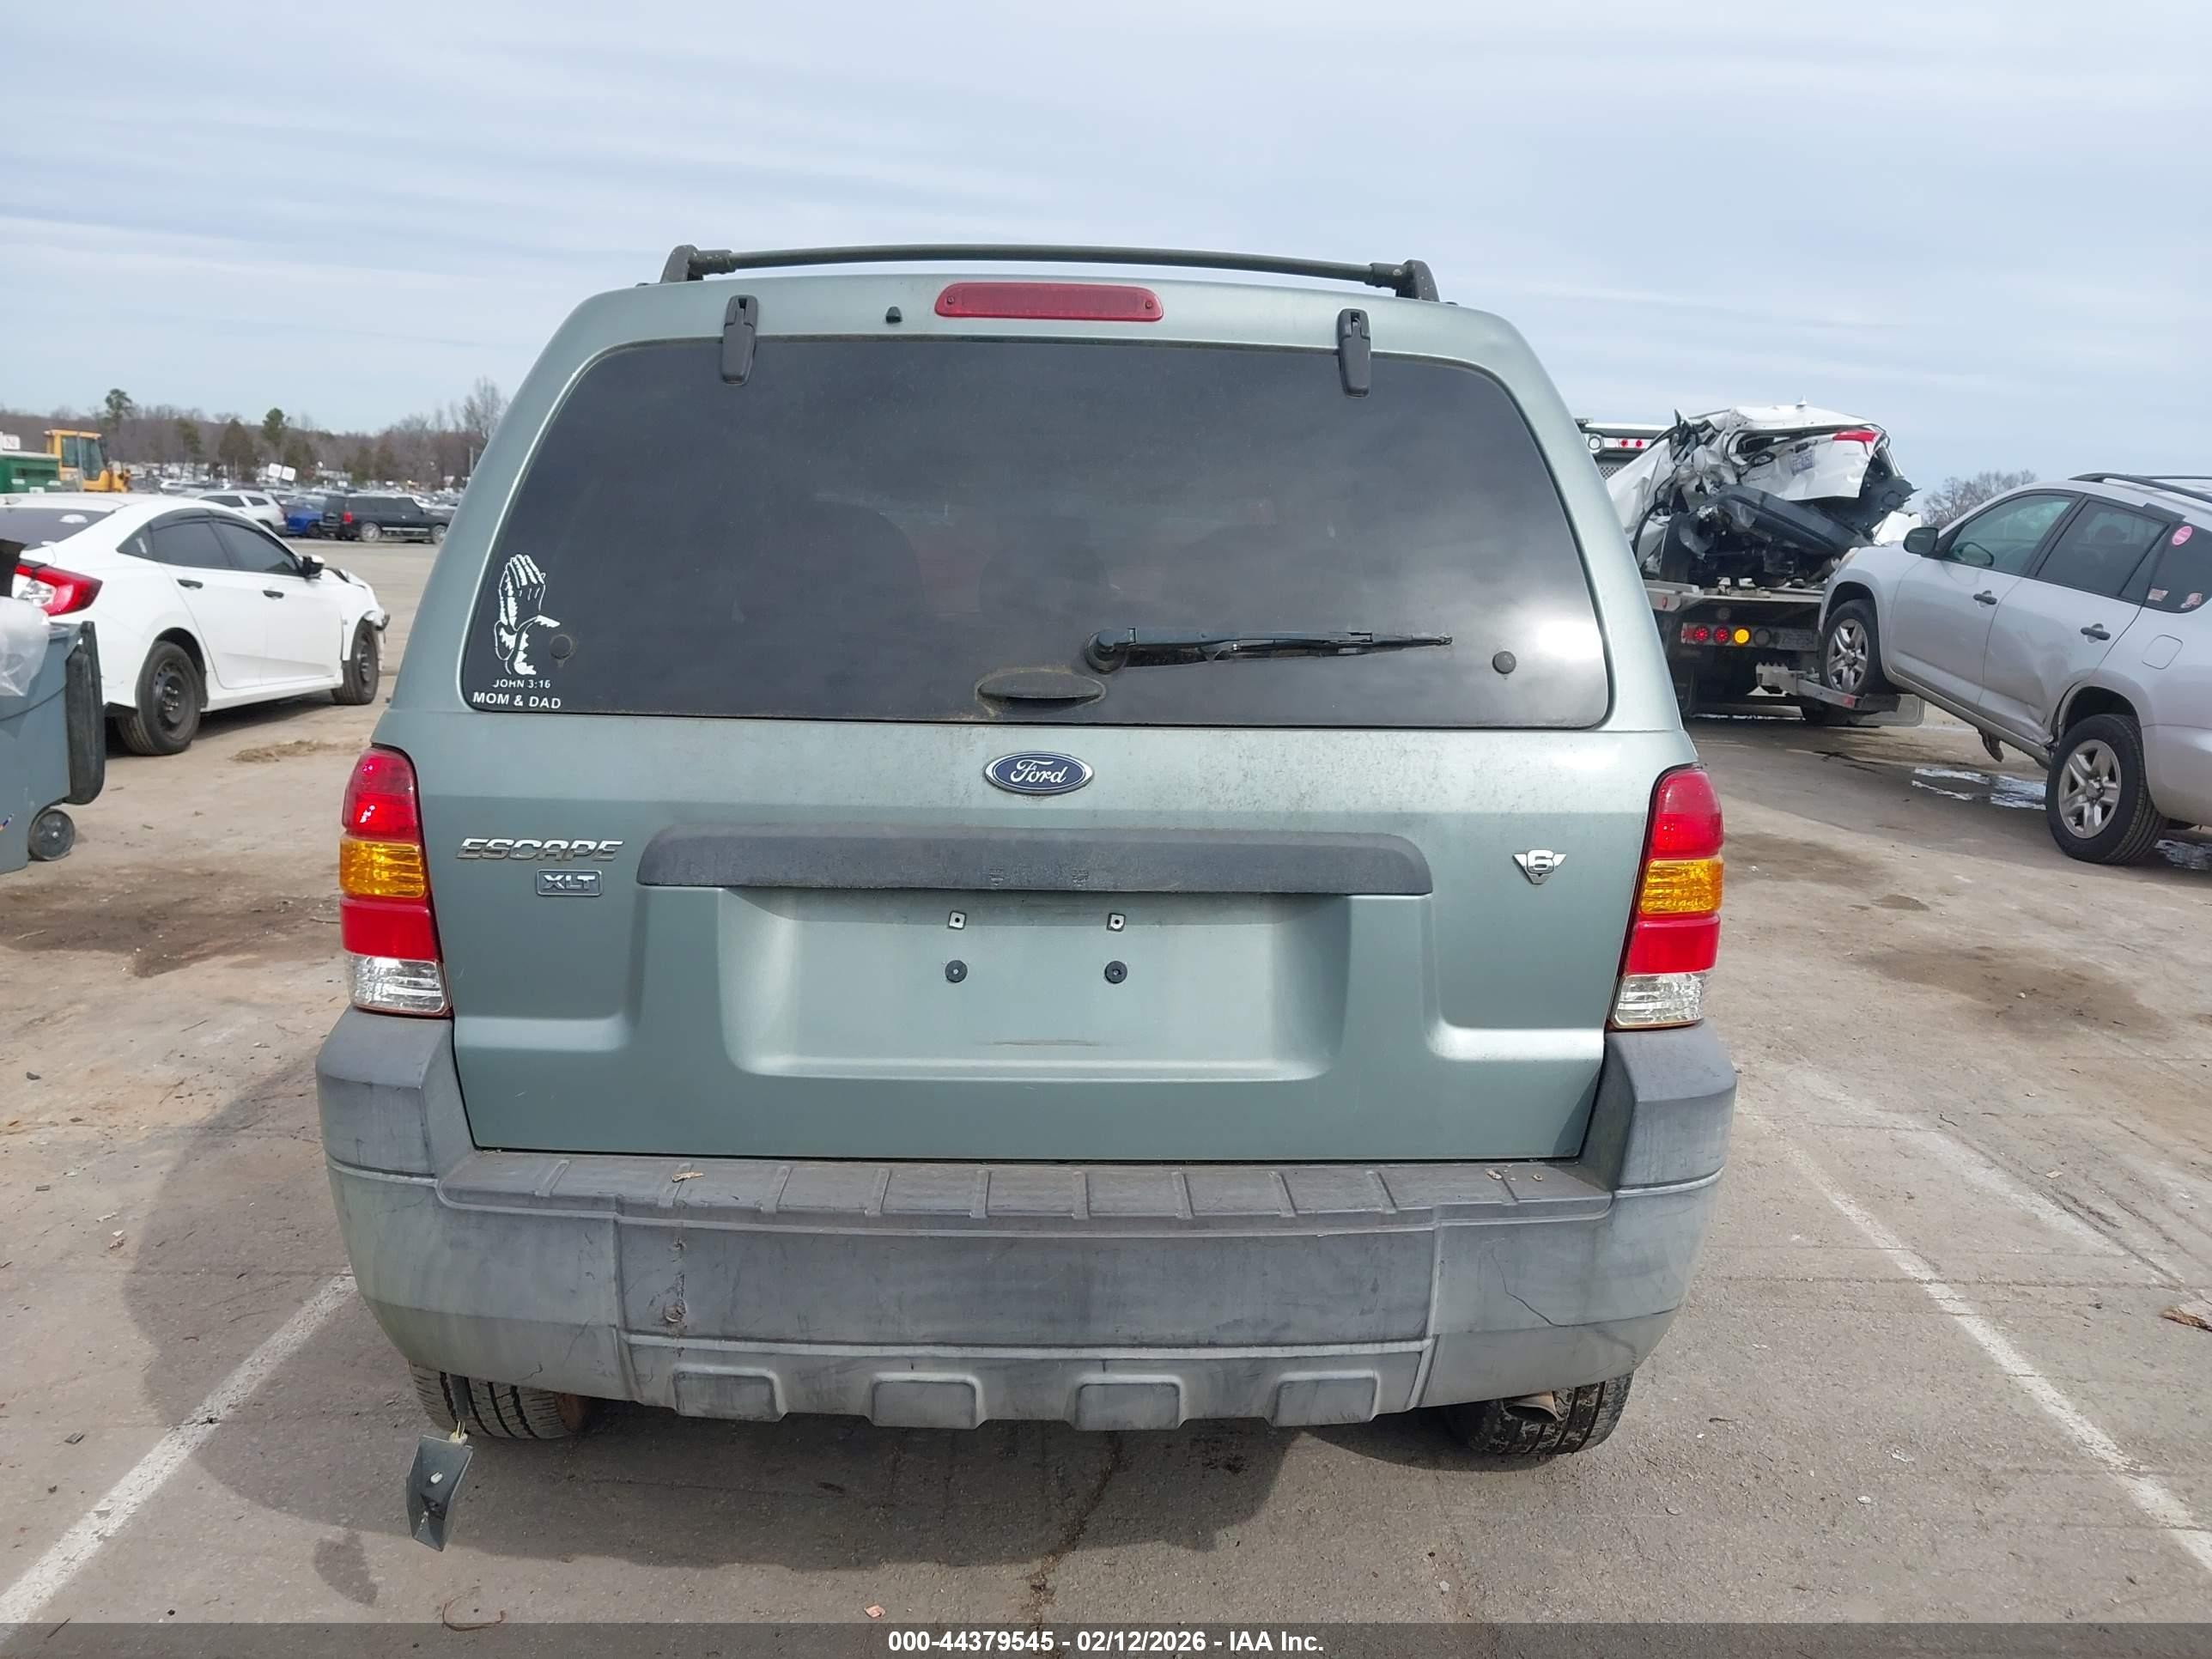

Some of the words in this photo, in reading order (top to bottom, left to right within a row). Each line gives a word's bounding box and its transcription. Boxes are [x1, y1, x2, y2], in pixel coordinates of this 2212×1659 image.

[492, 679, 526, 689] JOHN
[527, 679, 551, 689] 3:16
[472, 691, 509, 705] MOM
[514, 695, 525, 707] &
[529, 696, 562, 709] DAD
[1010, 759, 1069, 783] Ford
[456, 838, 624, 862] ESCAPE
[542, 874, 596, 890] XLT
